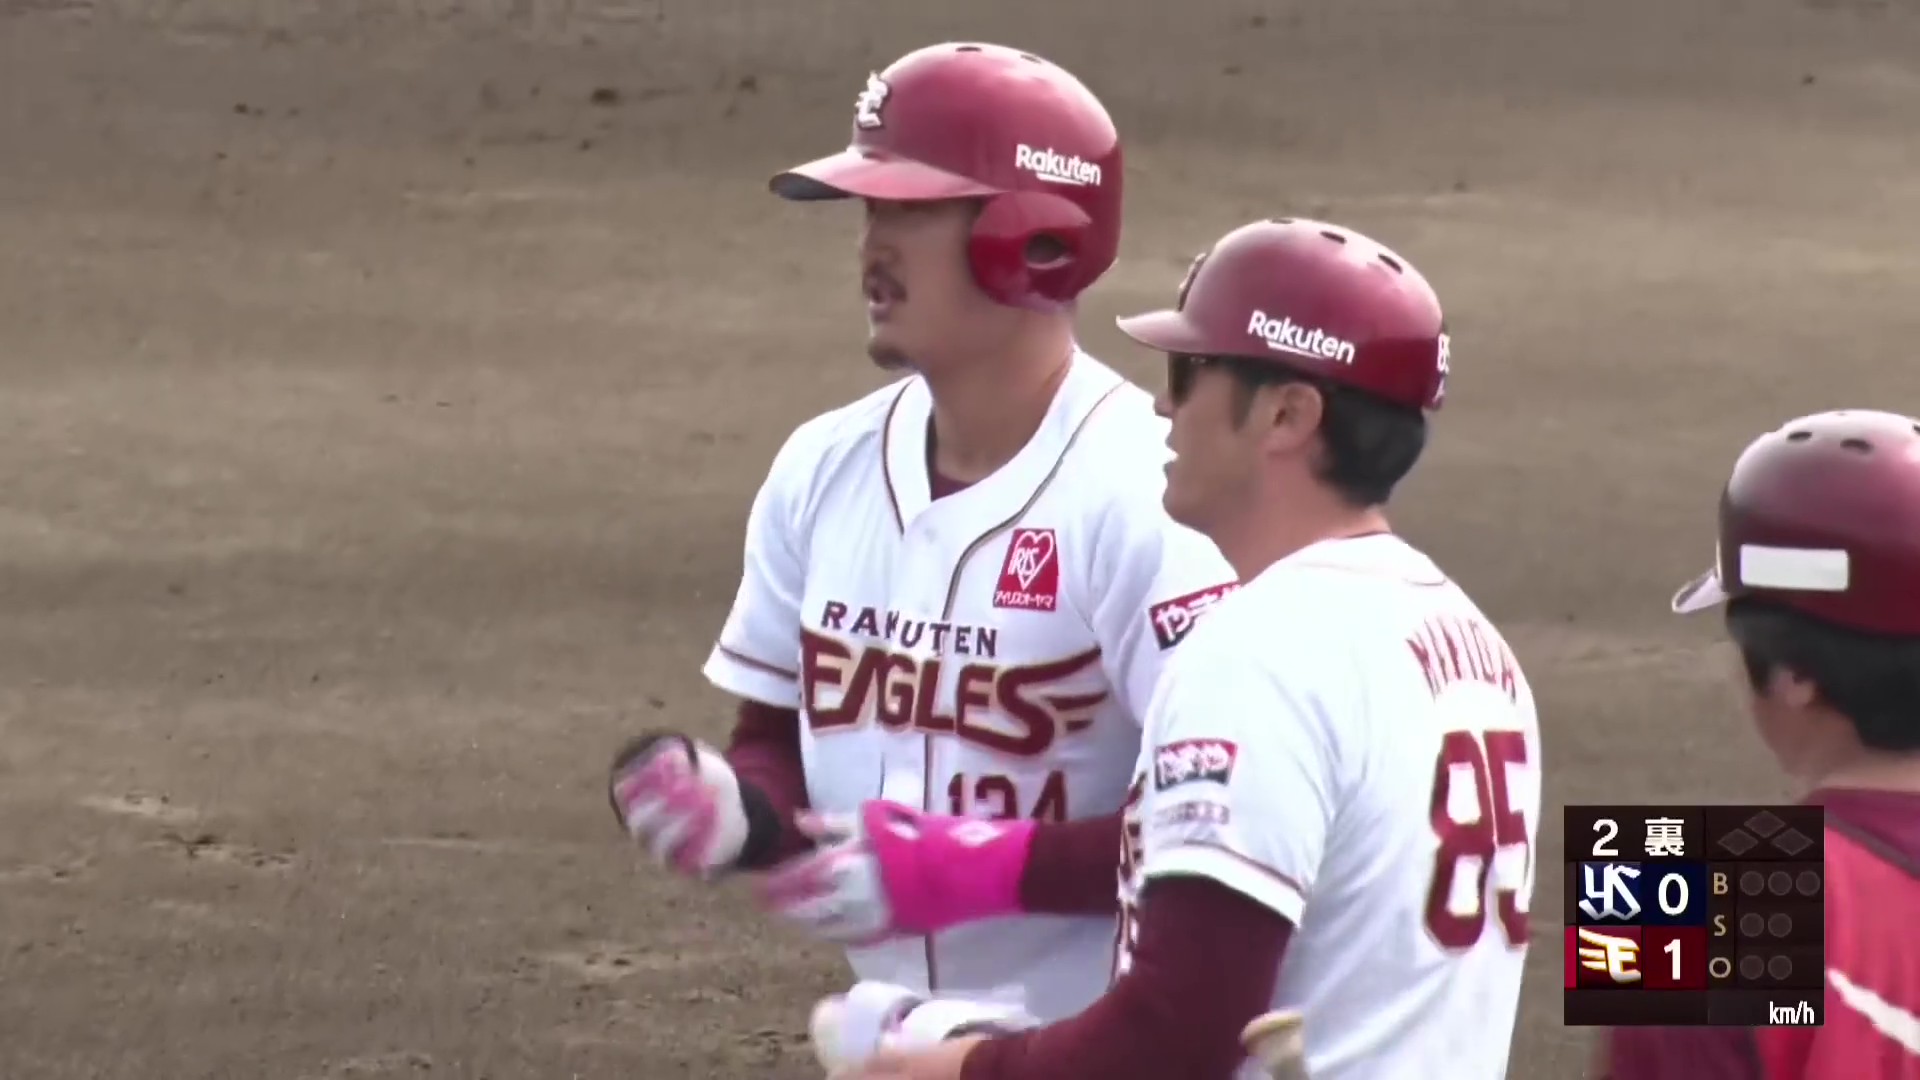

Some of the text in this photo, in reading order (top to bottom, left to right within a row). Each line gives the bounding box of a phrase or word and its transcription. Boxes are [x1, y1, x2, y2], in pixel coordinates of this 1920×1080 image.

[1015, 143, 1101, 186] Rakuten
[1247, 309, 1356, 365] Rakuten
[821, 600, 997, 658] RAKUTEN
[801, 627, 1108, 757] EAGLES
[1425, 729, 1530, 952] 85
